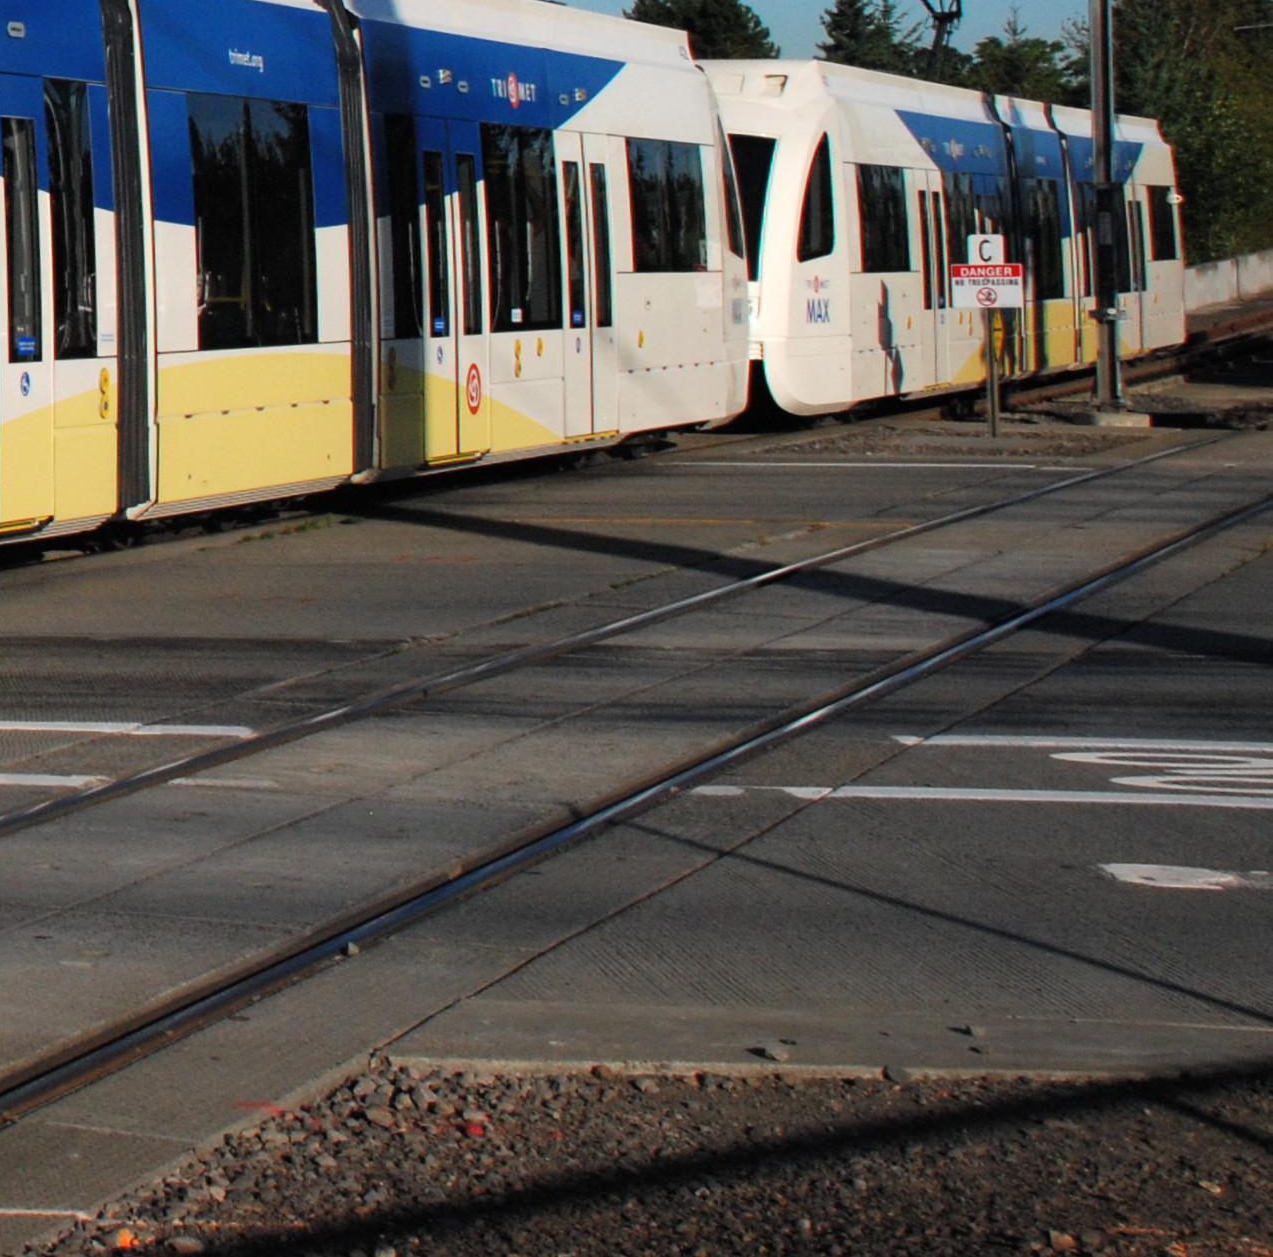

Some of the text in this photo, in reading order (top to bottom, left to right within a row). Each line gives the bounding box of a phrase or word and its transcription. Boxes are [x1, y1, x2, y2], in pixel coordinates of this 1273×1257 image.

[978, 239, 992, 263] C
[959, 266, 1013, 277] DANGER
[806, 298, 831, 324] MAX
